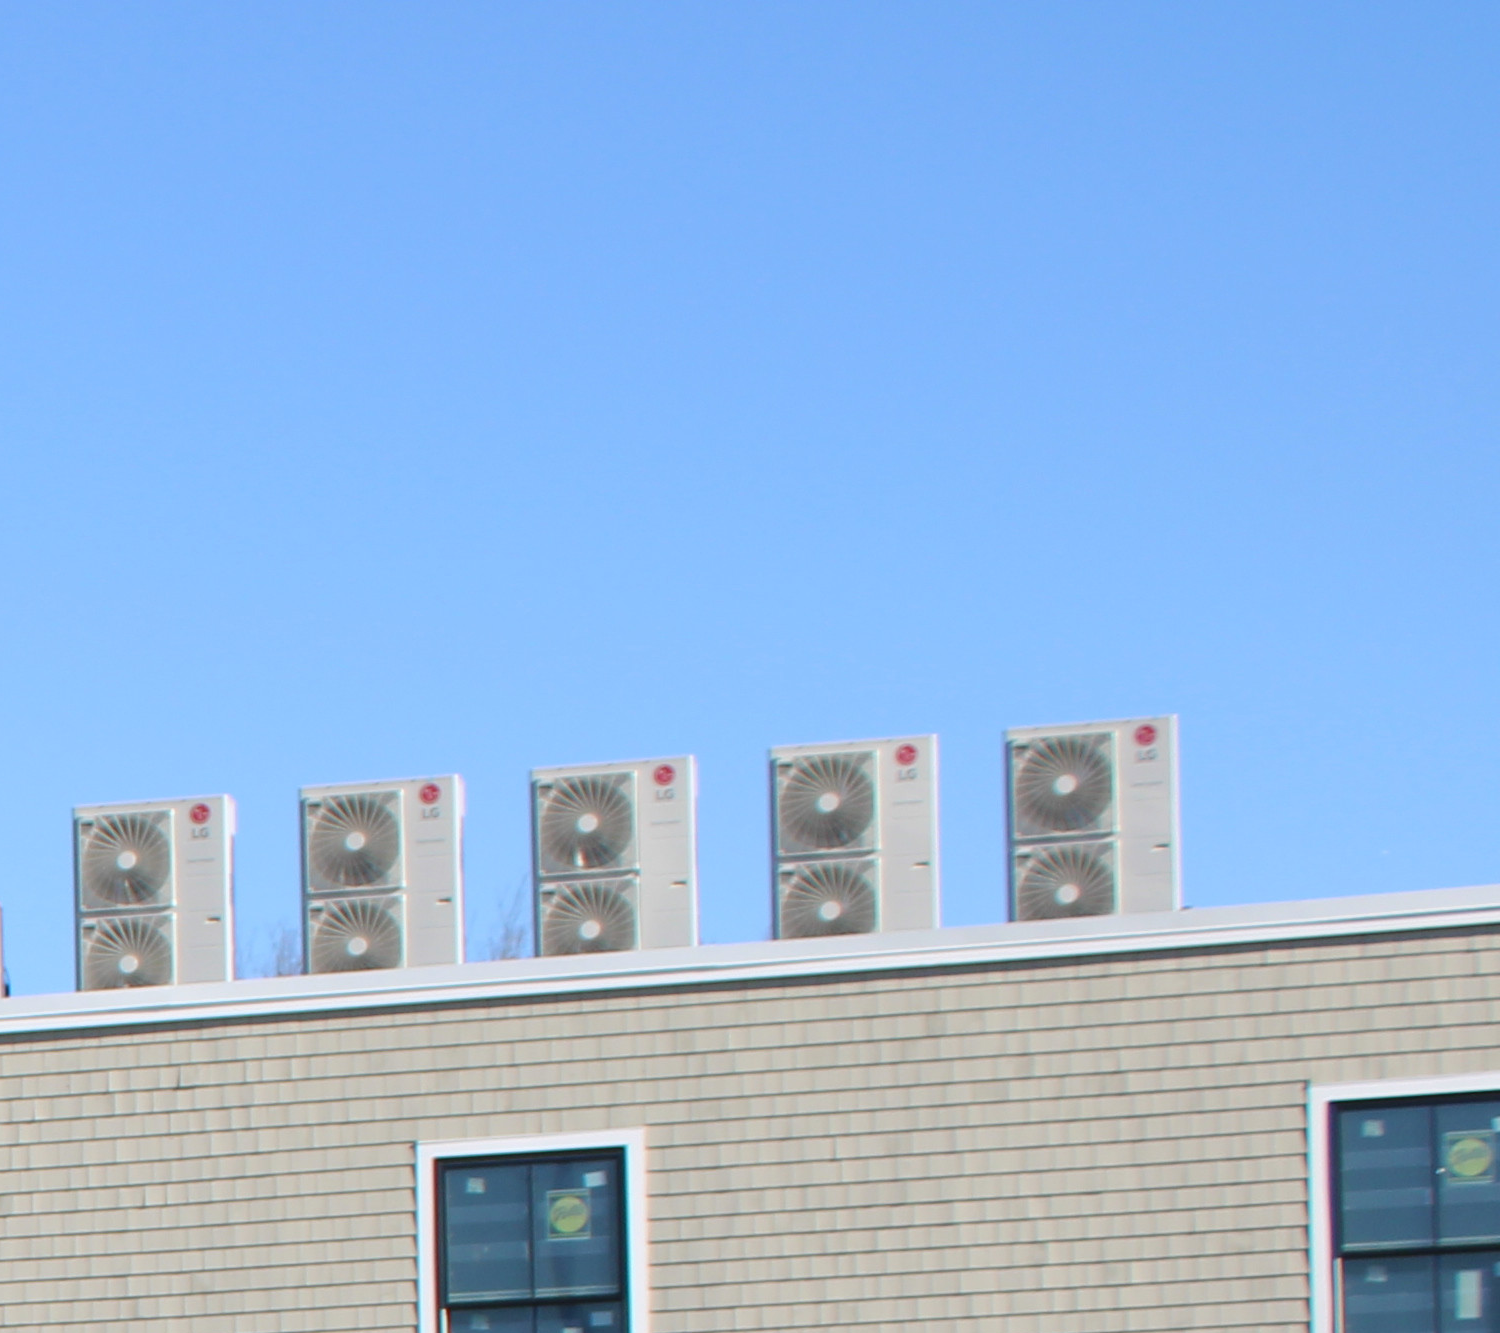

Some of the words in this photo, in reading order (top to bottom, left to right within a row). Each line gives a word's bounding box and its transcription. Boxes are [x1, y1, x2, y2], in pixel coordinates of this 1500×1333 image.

[656, 789, 674, 801] LG
[422, 807, 440, 819] LG
[191, 827, 209, 839] LG
